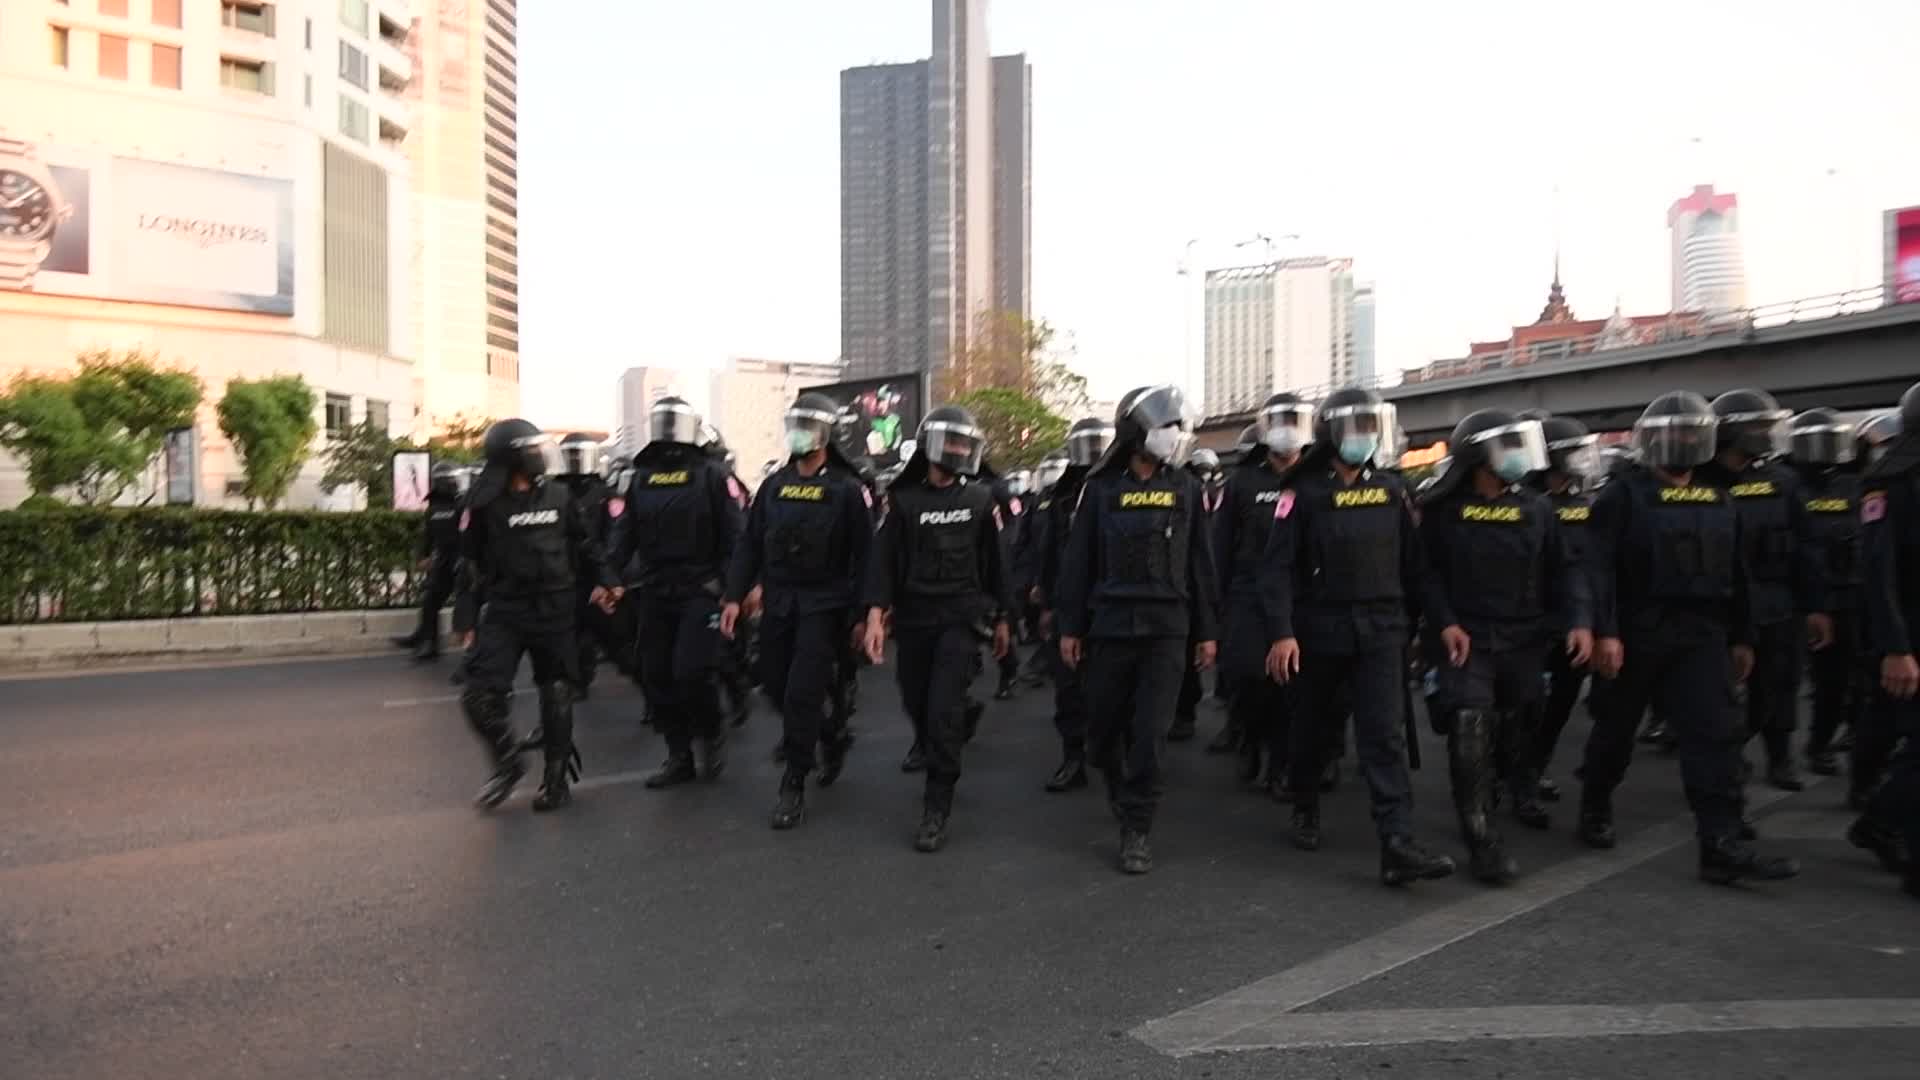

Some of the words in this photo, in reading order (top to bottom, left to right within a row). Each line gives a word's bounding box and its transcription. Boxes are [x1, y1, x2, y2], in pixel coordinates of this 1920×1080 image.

[649, 471, 688, 485] POLICE
[779, 486, 823, 500] POLICE
[1121, 492, 1173, 506] POLICE
[1335, 489, 1387, 506] POLICE
[508, 510, 558, 527] POLICE
[920, 509, 971, 524] POLICE
[1463, 505, 1520, 520] POLICE
